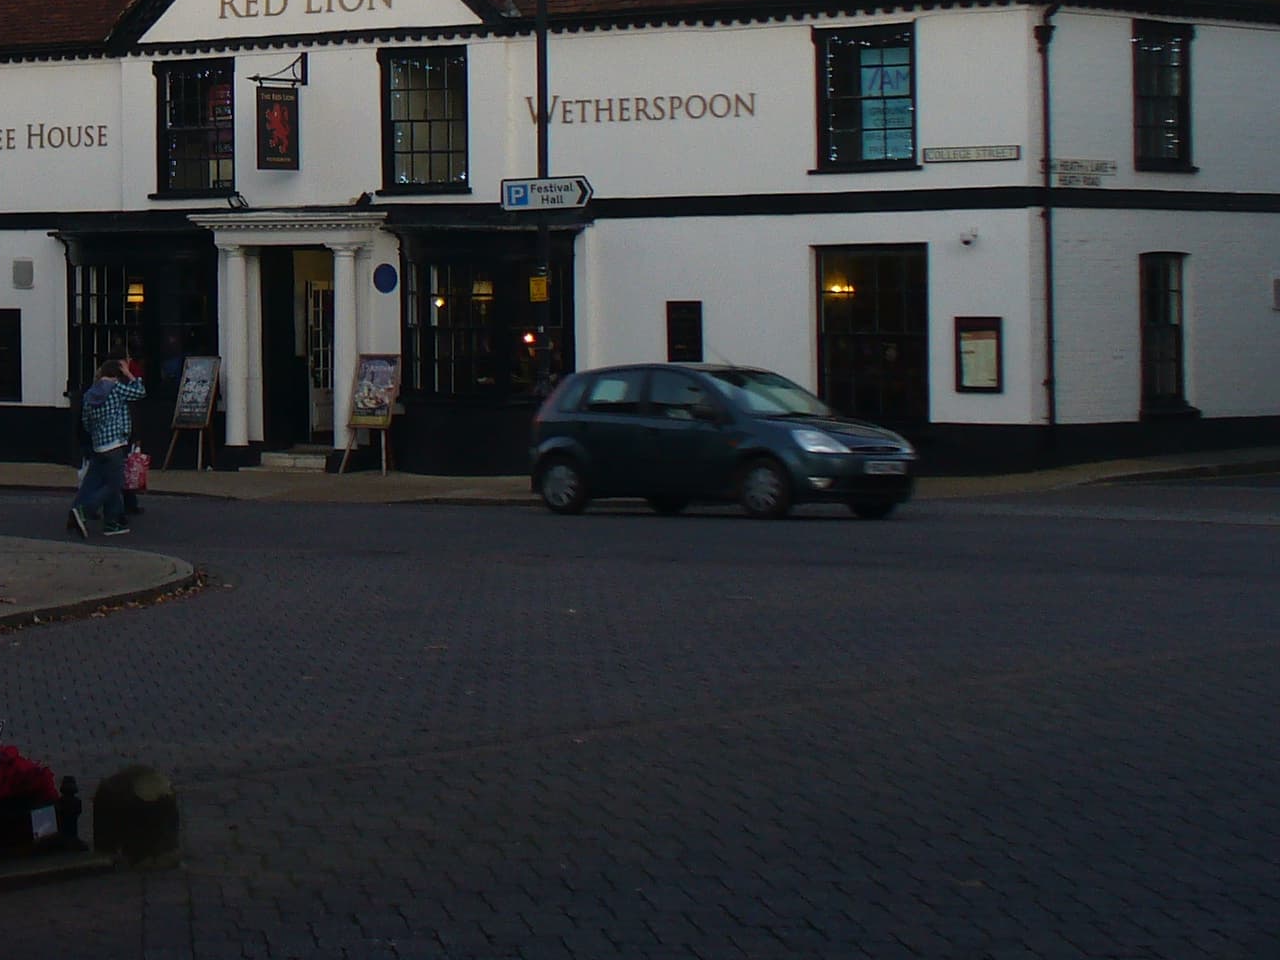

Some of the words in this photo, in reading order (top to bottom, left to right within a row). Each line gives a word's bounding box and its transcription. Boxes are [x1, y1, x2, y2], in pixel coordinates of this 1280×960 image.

[26, 123, 108, 149] HOUSE
[926, 149, 971, 160] COLLEGE
[976, 147, 1015, 158] STREET
[530, 183, 574, 193] Festival
[540, 194, 564, 204] Hall
